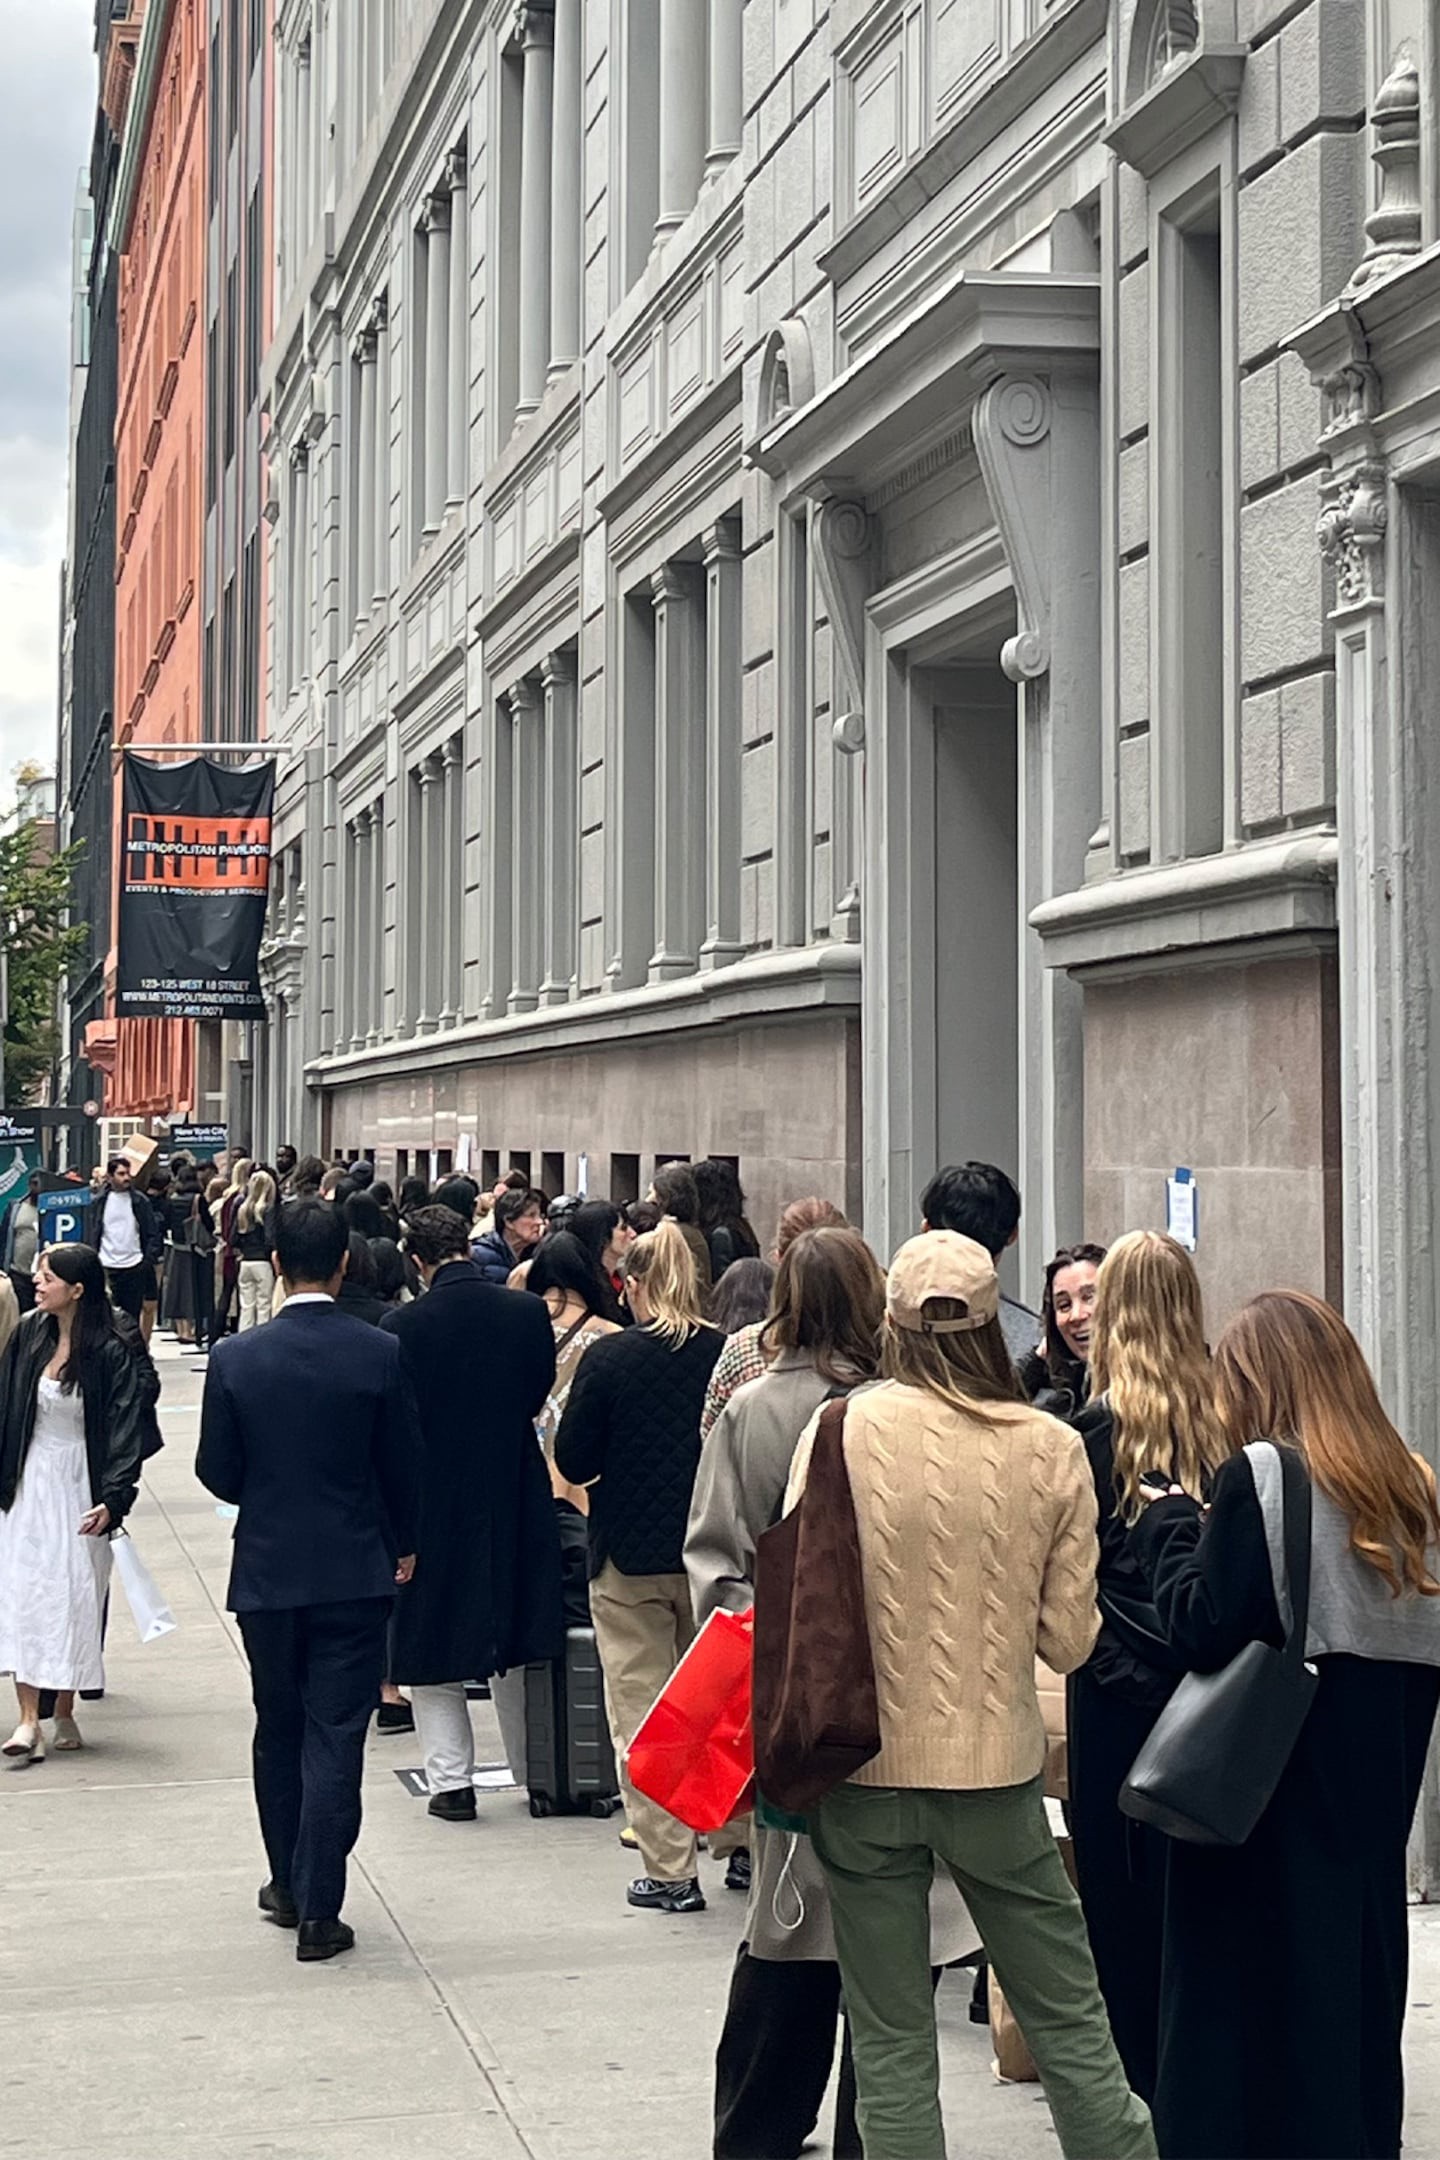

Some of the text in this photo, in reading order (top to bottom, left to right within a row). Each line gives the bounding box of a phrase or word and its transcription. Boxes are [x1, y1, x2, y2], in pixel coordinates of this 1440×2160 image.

[127, 841, 270, 855] METROPOLITAN PAVILION
[125, 885, 159, 893] EVENTS
[169, 887, 226, 896] PRODUCTION
[141, 979, 178, 989] 123-125
[178, 979, 203, 990] WEST
[218, 980, 250, 991] STREET
[211, 1127, 229, 1137] City
[55, 1213, 76, 1242] P
